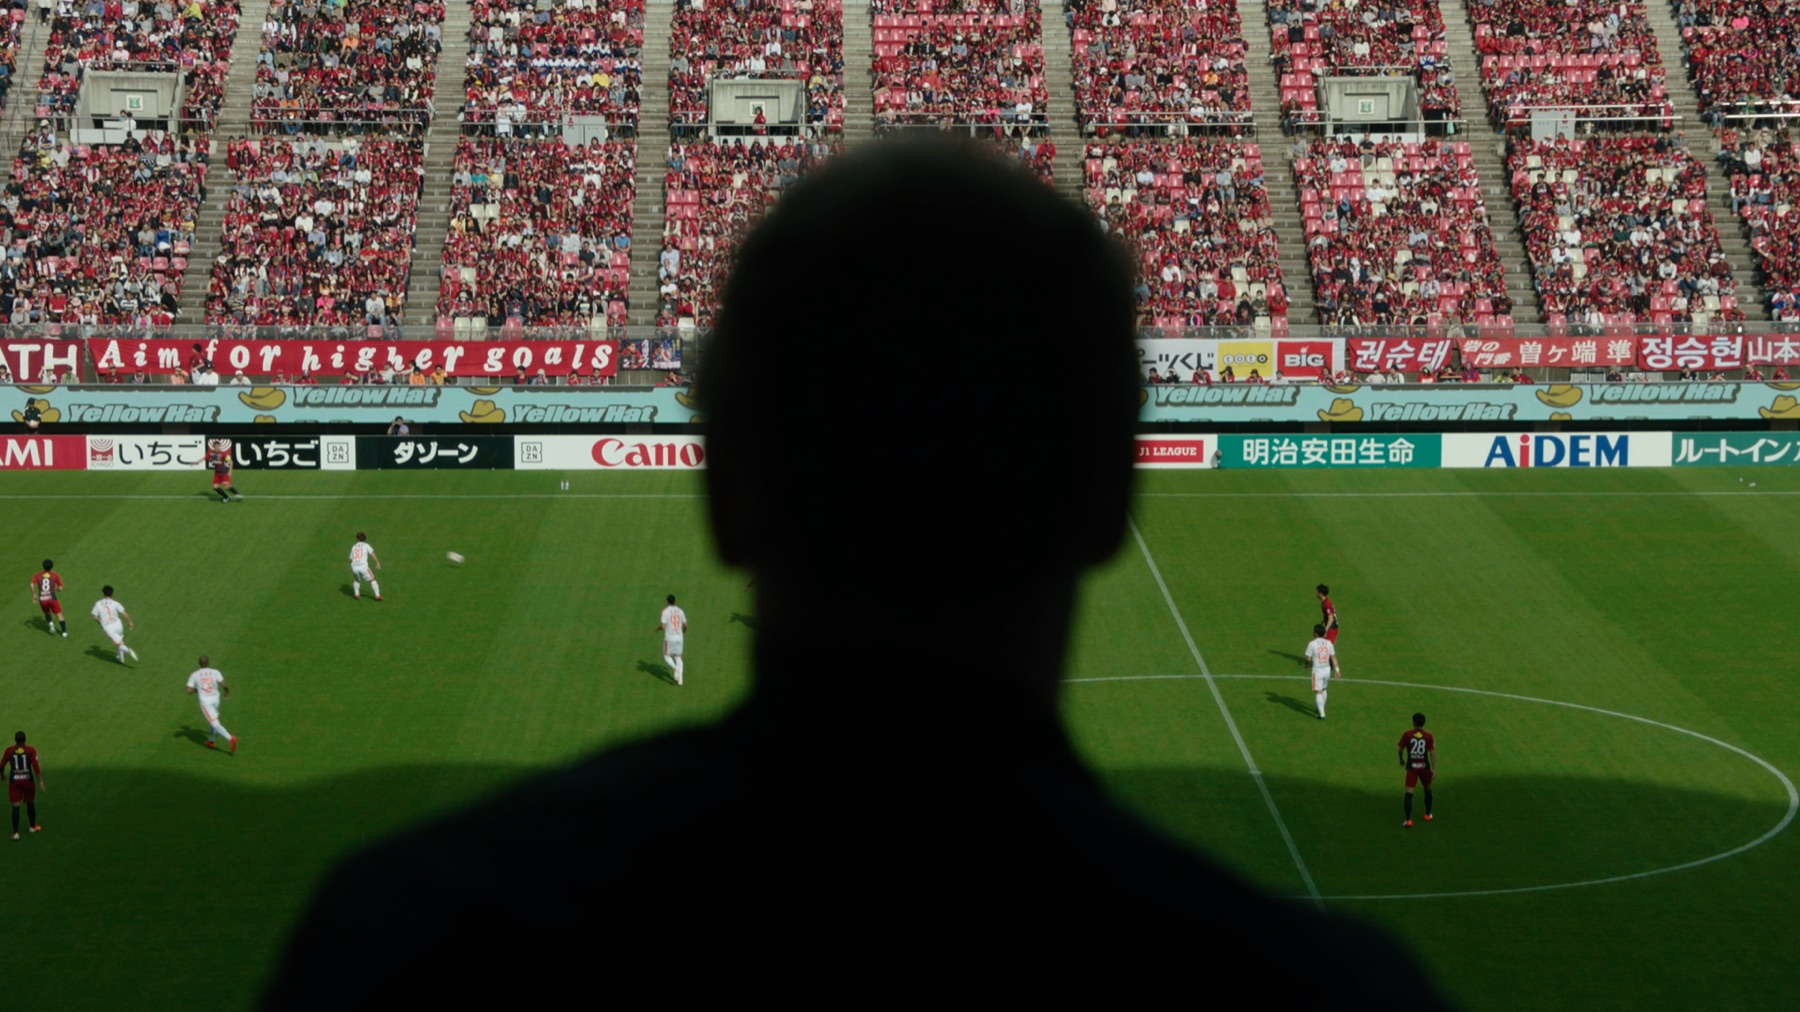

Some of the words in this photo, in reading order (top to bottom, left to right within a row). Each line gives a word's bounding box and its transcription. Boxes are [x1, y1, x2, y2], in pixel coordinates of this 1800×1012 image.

[98, 340, 180, 369] Aim
[206, 338, 281, 372] for
[301, 344, 464, 373] higher
[484, 345, 613, 371] goals
[1137, 348, 1214, 370] ーツくじ
[1356, 340, 1451, 370] 권순태
[1642, 336, 1743, 368] 정승현
[1748, 336, 1800, 362] 山本
[0, 439, 53, 466] MI
[119, 440, 202, 465] いちご
[235, 440, 319, 467] いちご
[394, 441, 478, 463] ダゾーン
[591, 438, 704, 467] Cano
[1139, 447, 1150, 456] J1
[1153, 447, 1197, 456] LEAGUE
[1243, 438, 1415, 465] 明治安田生命
[1676, 438, 1800, 463] ルートイン
[42, 578, 50, 592] 8
[1410, 738, 1426, 755] 28
[13, 754, 28, 772] 11
